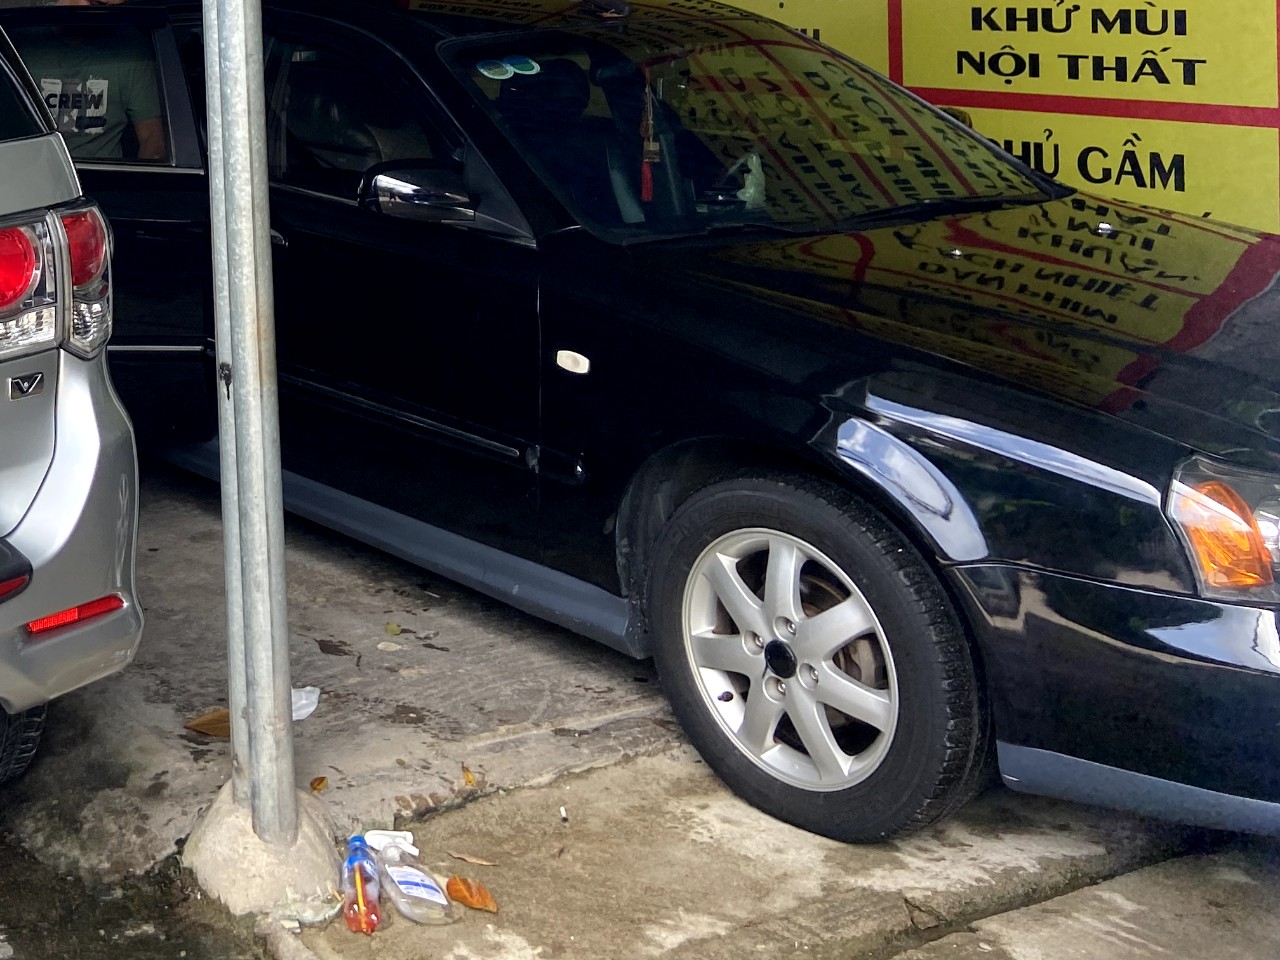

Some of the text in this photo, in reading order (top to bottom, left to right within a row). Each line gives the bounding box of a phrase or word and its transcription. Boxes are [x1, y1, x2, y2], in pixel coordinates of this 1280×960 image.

[1091, 1, 1187, 36] MÙI
[956, 45, 1207, 86] NỘI THẤT
[45, 90, 103, 109] CREW
[987, 128, 1185, 192] HỦ GẦM
